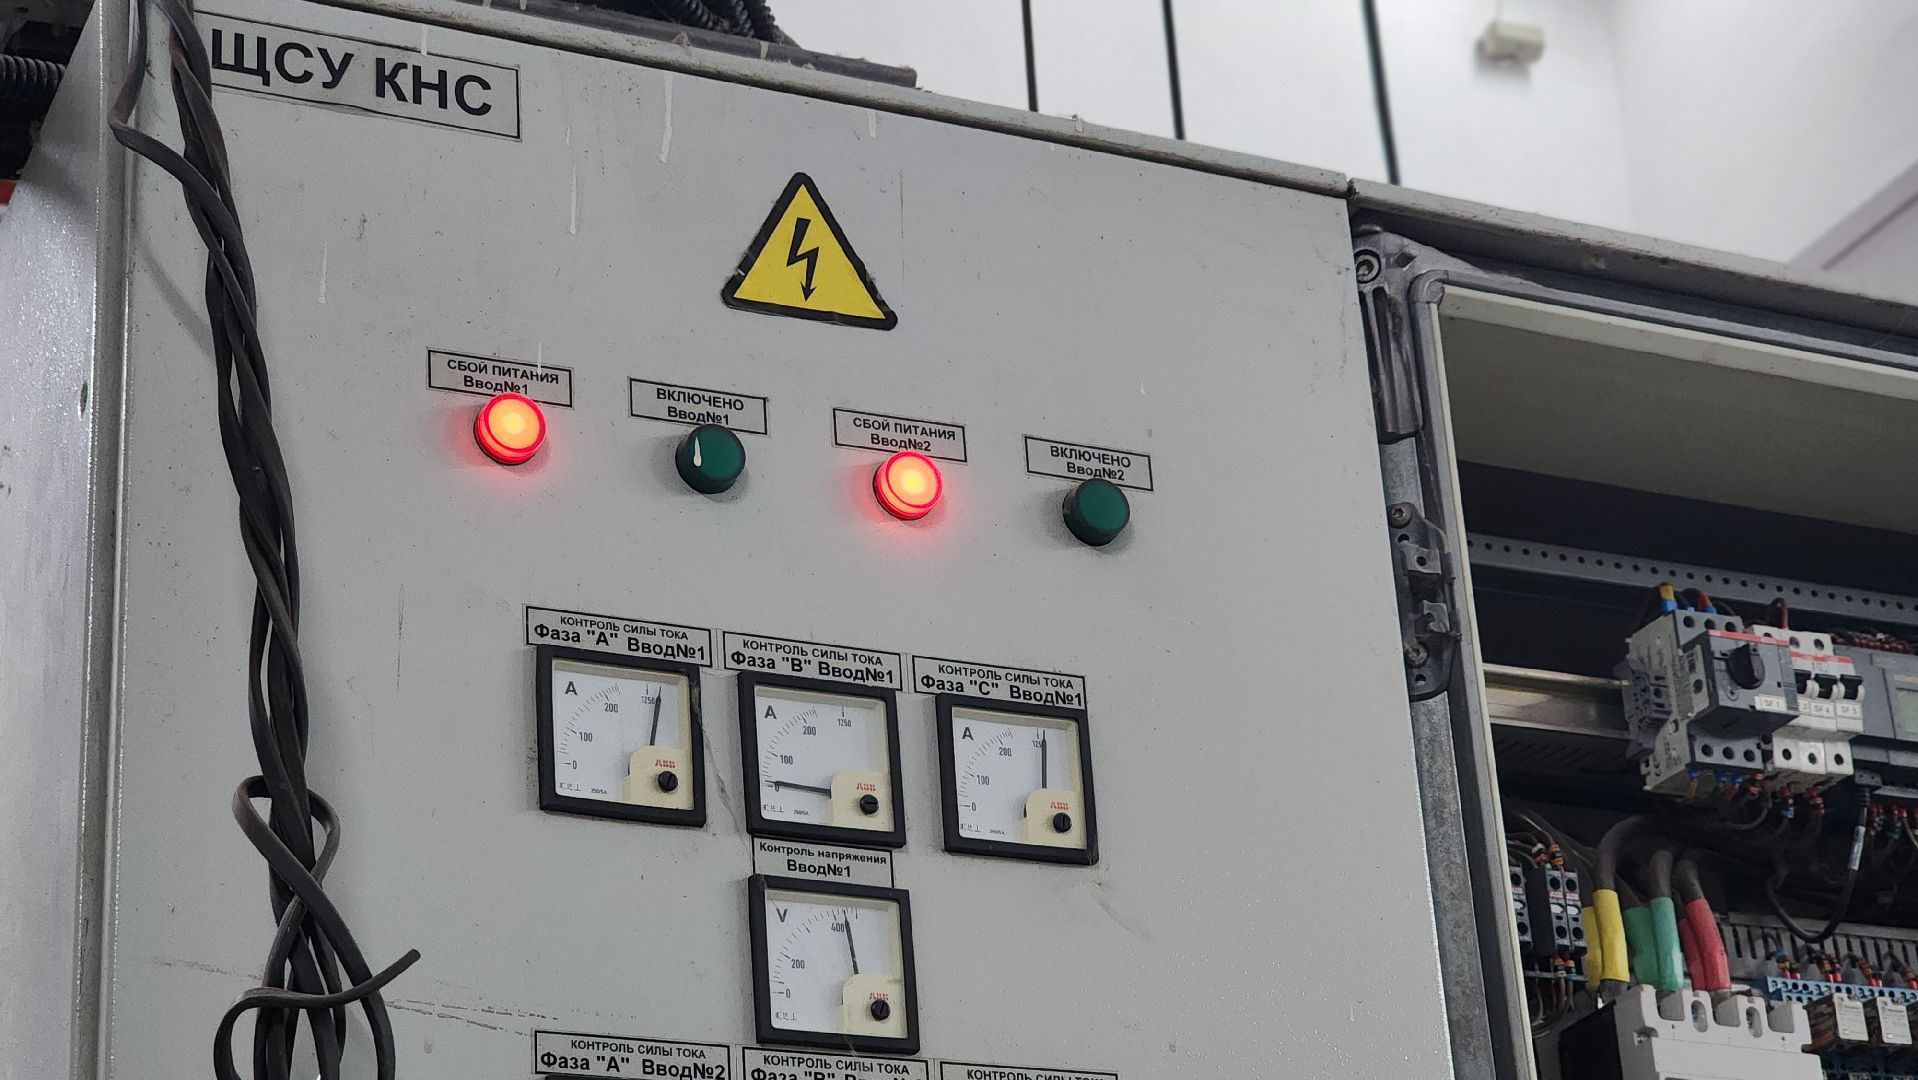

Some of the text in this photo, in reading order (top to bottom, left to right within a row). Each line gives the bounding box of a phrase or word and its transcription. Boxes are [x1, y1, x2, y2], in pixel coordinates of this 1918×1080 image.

[211, 28, 492, 116] ЩСУ КНС
[447, 358, 559, 385] СБОЙ ПИТАНИЯ
[463, 375, 529, 395] Ввод№1
[656, 387, 744, 411] ВКЛЮЧЕНО
[667, 405, 729, 425] Ввод№1
[853, 417, 956, 441] СБОЙ ПИТАНИЯ
[870, 433, 931, 452] Ввод№2
[1050, 445, 1131, 468] ВКЛЮЧЕНО
[1066, 461, 1125, 481] Ввод№2
[560, 615, 688, 640] КОНТРОЛЬ СИЛЫ ТОКА
[534, 623, 581, 643] Фаза
[627, 636, 705, 660] Ввод№1
[742, 638, 883, 666] КОНТРОЛЬ СИЛЫ ТОКА
[731, 650, 776, 671] Фаза
[818, 661, 894, 684] Ввод№1
[938, 663, 1074, 690] КОНТРОЛЬ СИЛЫ ТОКА
[564, 680, 578, 696] A
[920, 674, 965, 693] Фаза
[1009, 686, 1083, 707] Ввод№1
[604, 702, 619, 713] 200
[764, 705, 777, 720] A
[803, 725, 817, 737] 200
[837, 718, 852, 728] 1250
[578, 731, 593, 743] 100
[961, 726, 974, 740] A
[998, 747, 1012, 757] 200
[1032, 740, 1044, 749] 125
[571, 760, 578, 770] 0
[654, 758, 676, 769] ABB
[779, 754, 794, 765] 100
[856, 782, 877, 792] ABB
[976, 775, 990, 785] 100
[971, 801, 977, 812] 0
[759, 841, 888, 865] Контроль напряжения
[786, 859, 851, 878] Ввод№1
[776, 908, 788, 922] V
[831, 922, 845, 932] 400
[791, 959, 805, 969] 200
[785, 989, 791, 999] 0
[570, 1038, 707, 1060] КОНТРОЛЬ СИЛЫ ТОКА
[540, 1051, 592, 1074] Фаза
[642, 1057, 727, 1080] Ввод№2
[763, 1054, 910, 1076] КОНТРОЛЬ СИЛЫ ТОКА
